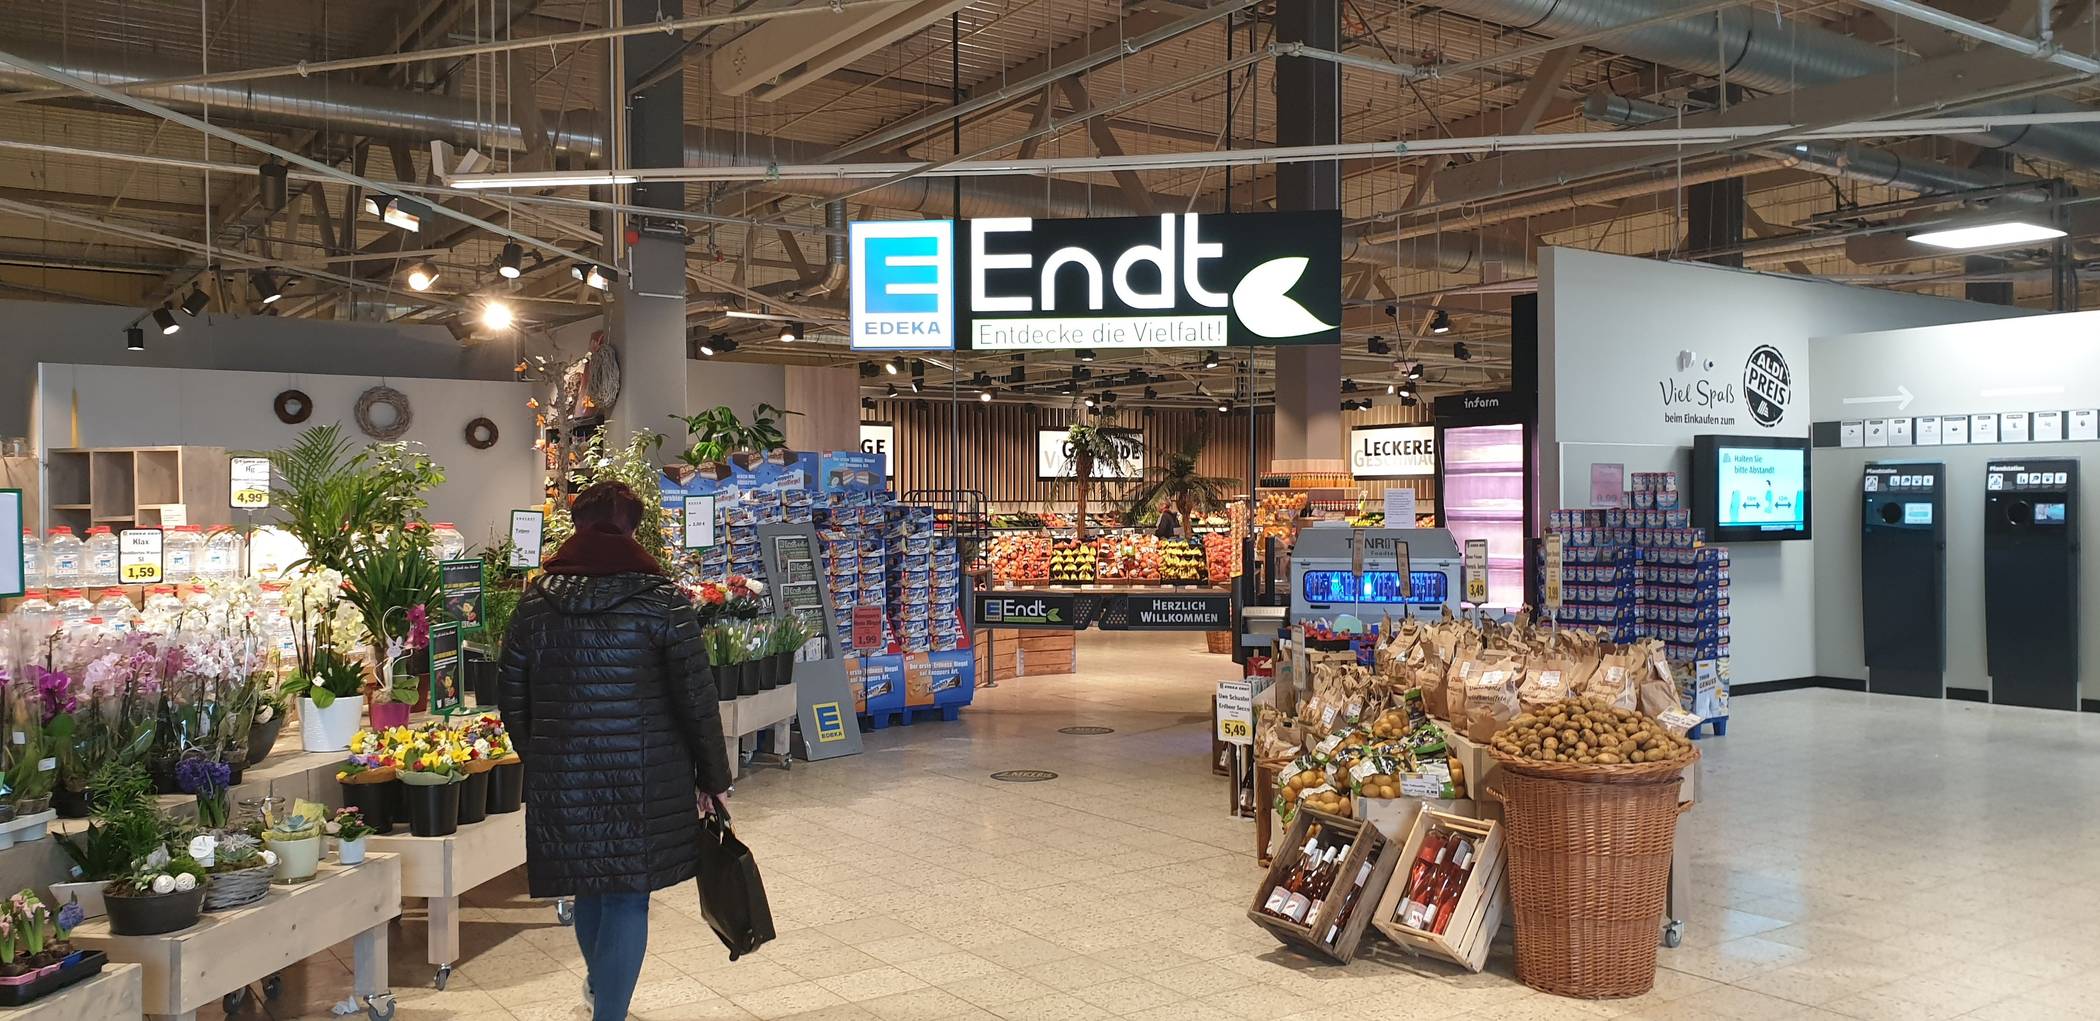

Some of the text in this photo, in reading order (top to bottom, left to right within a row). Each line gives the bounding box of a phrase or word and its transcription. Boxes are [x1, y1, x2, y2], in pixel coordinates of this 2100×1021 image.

[971, 213, 1228, 311] Endt
[865, 321, 941, 335] EDEKA
[980, 320, 1221, 345] Entdecke die Vielfalt!
[1757, 353, 1784, 380] ALDI
[1749, 367, 1786, 406] PREIS
[1659, 378, 1734, 409] Viel Spaß
[1464, 397, 1499, 408] infarm
[1665, 413, 1735, 425] beim Einkaufen zum
[1734, 455, 1754, 463] Halten
[1734, 466, 1748, 474] bitte
[237, 493, 263, 504] 4,99
[128, 567, 155, 579] 1,59
[1003, 600, 1047, 616] Endt
[1152, 600, 1206, 611] HERZLICH
[1140, 611, 1218, 623] WILLKOMMEN
[1224, 723, 1246, 737] 5,49
